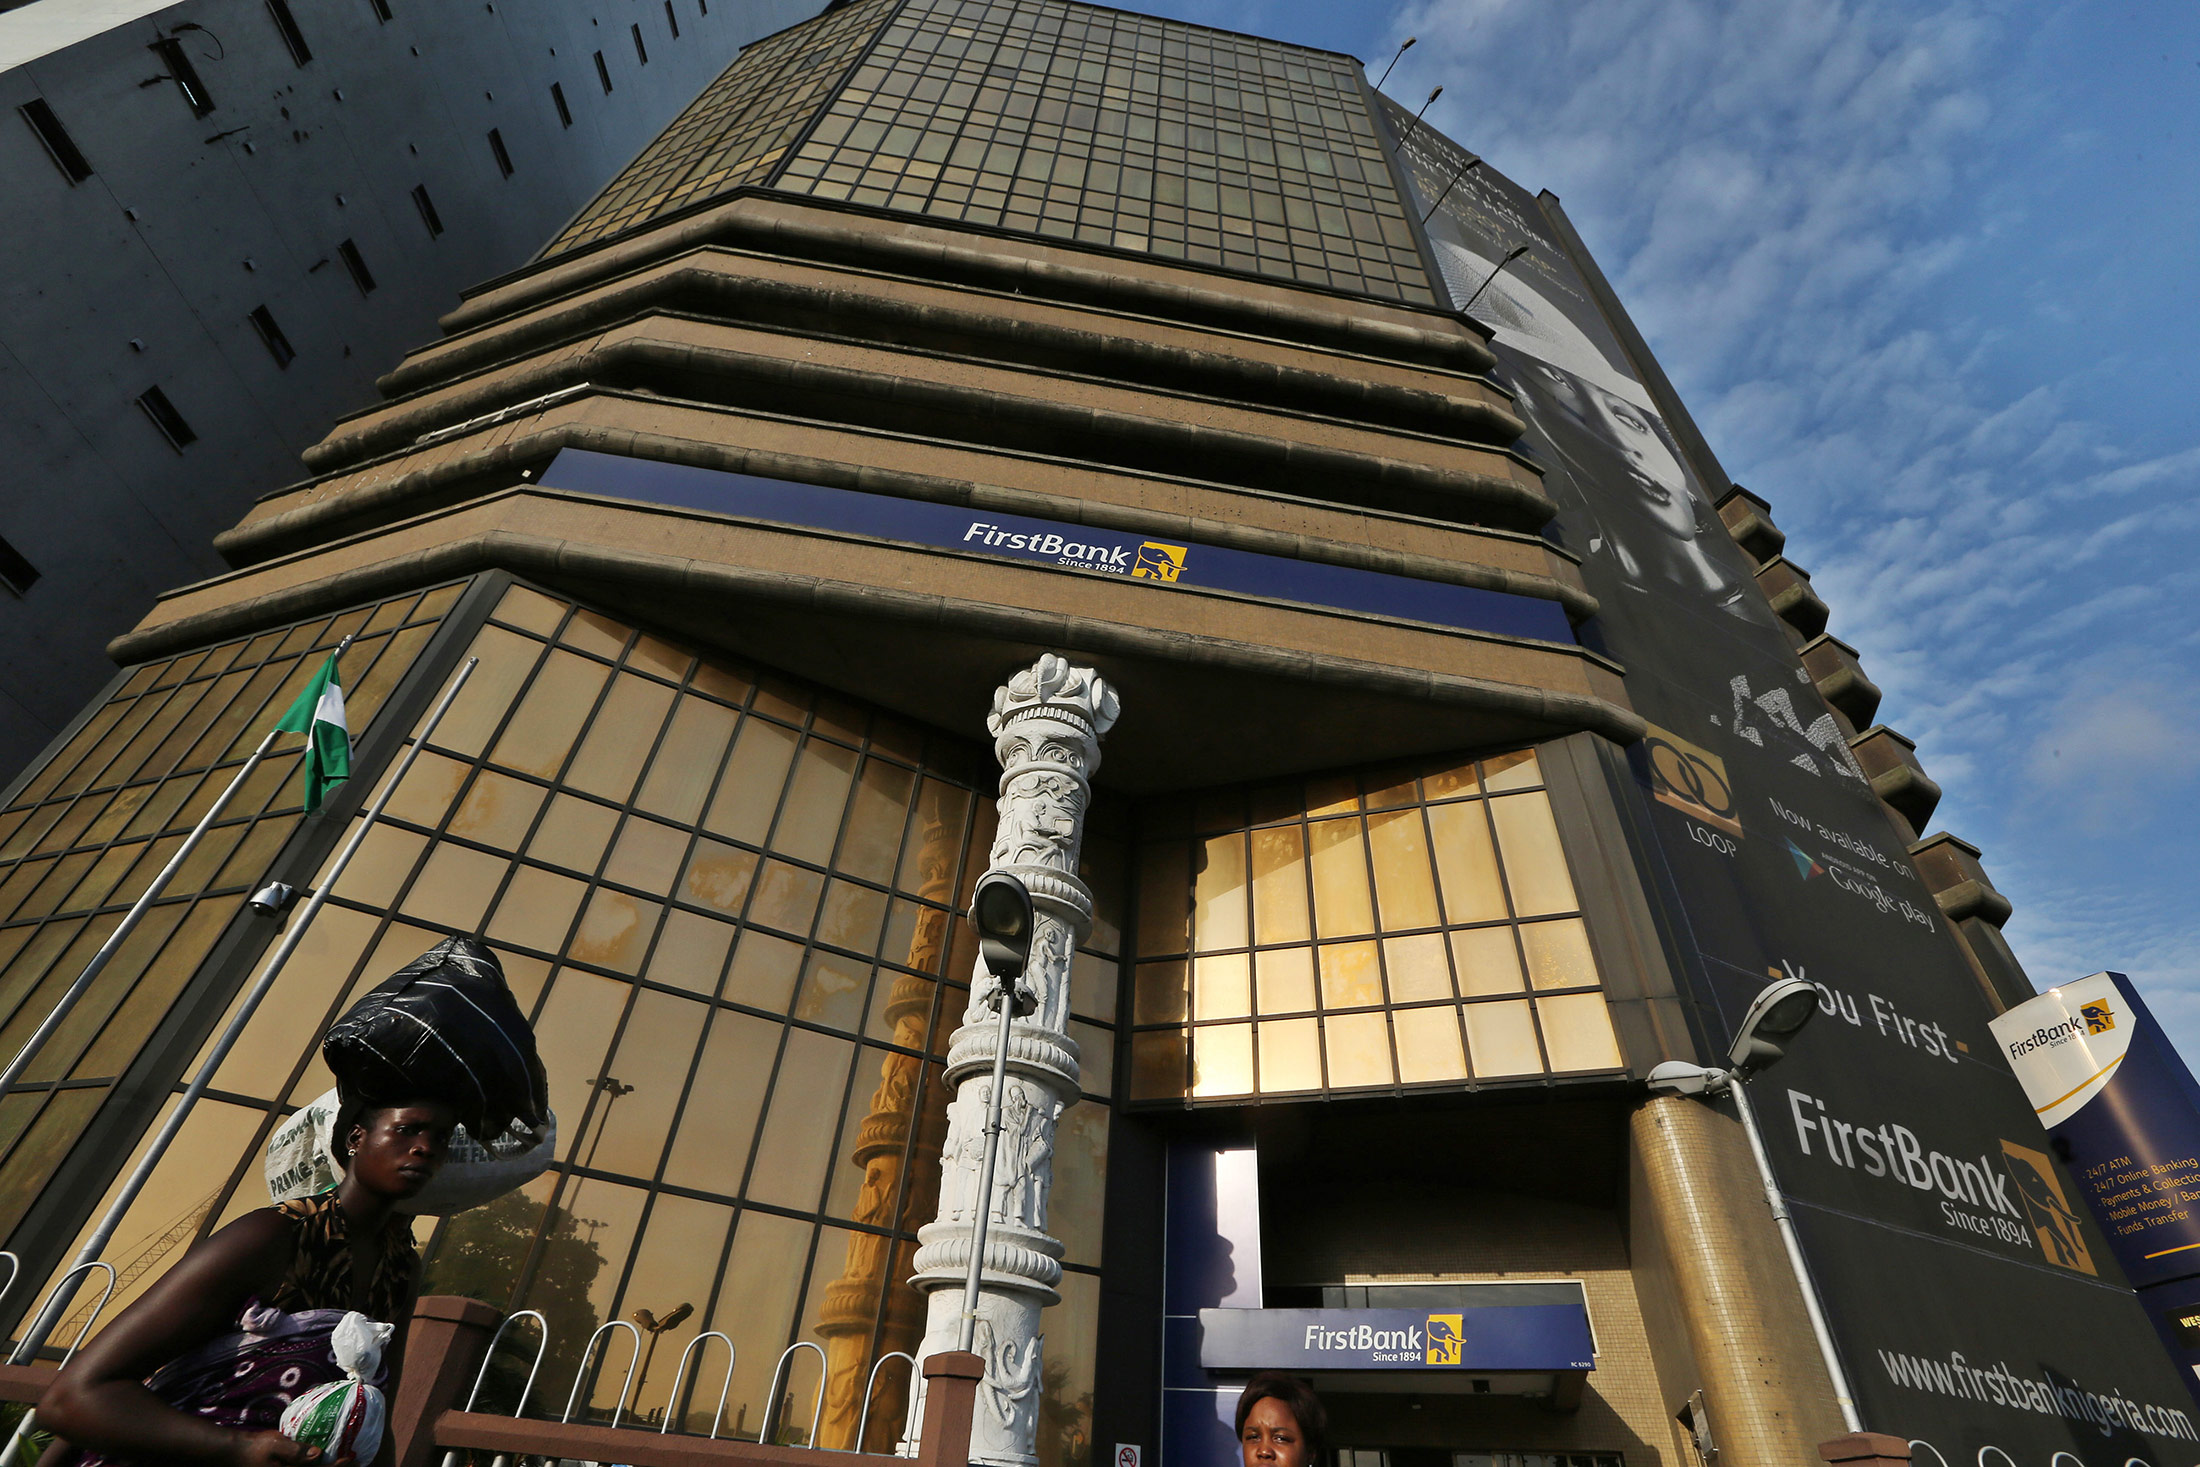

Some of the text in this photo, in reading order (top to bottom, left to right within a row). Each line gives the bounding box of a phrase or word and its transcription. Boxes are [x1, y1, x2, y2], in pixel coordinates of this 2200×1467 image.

[1400, 137, 1480, 195] BECAUSE
[1496, 201, 1528, 228] SEE
[1402, 146, 1440, 177] THE
[1446, 176, 1477, 201] BIG
[963, 522, 1132, 567] FirstBank
[1057, 556, 1125, 575] Since 1894
[1686, 821, 1737, 858] LOOP
[1768, 797, 1916, 881] Now available on
[1828, 865, 1936, 933] Google play
[1868, 993, 1959, 1064] First
[2008, 1016, 2083, 1060] FirstBank
[2049, 1038, 2068, 1049] Since
[1787, 1088, 2023, 1220] FirstBank
[2085, 1156, 2133, 1180] 24/7 ATM
[2093, 1157, 2199, 1193] 24/7 Online Banking
[2101, 1187, 2142, 1208] Payments
[2142, 1184, 2153, 1194] &
[2109, 1205, 2138, 1221] Mobile
[2137, 1196, 2172, 1213] Money
[1940, 1201, 2033, 1249] Since 1894
[2117, 1210, 2190, 1236] Funds Transfer
[1304, 1323, 1422, 1350] FirstBank
[1372, 1352, 1422, 1362] Since 1894
[1878, 1349, 2200, 1442] www.firstbanknigeria.com
